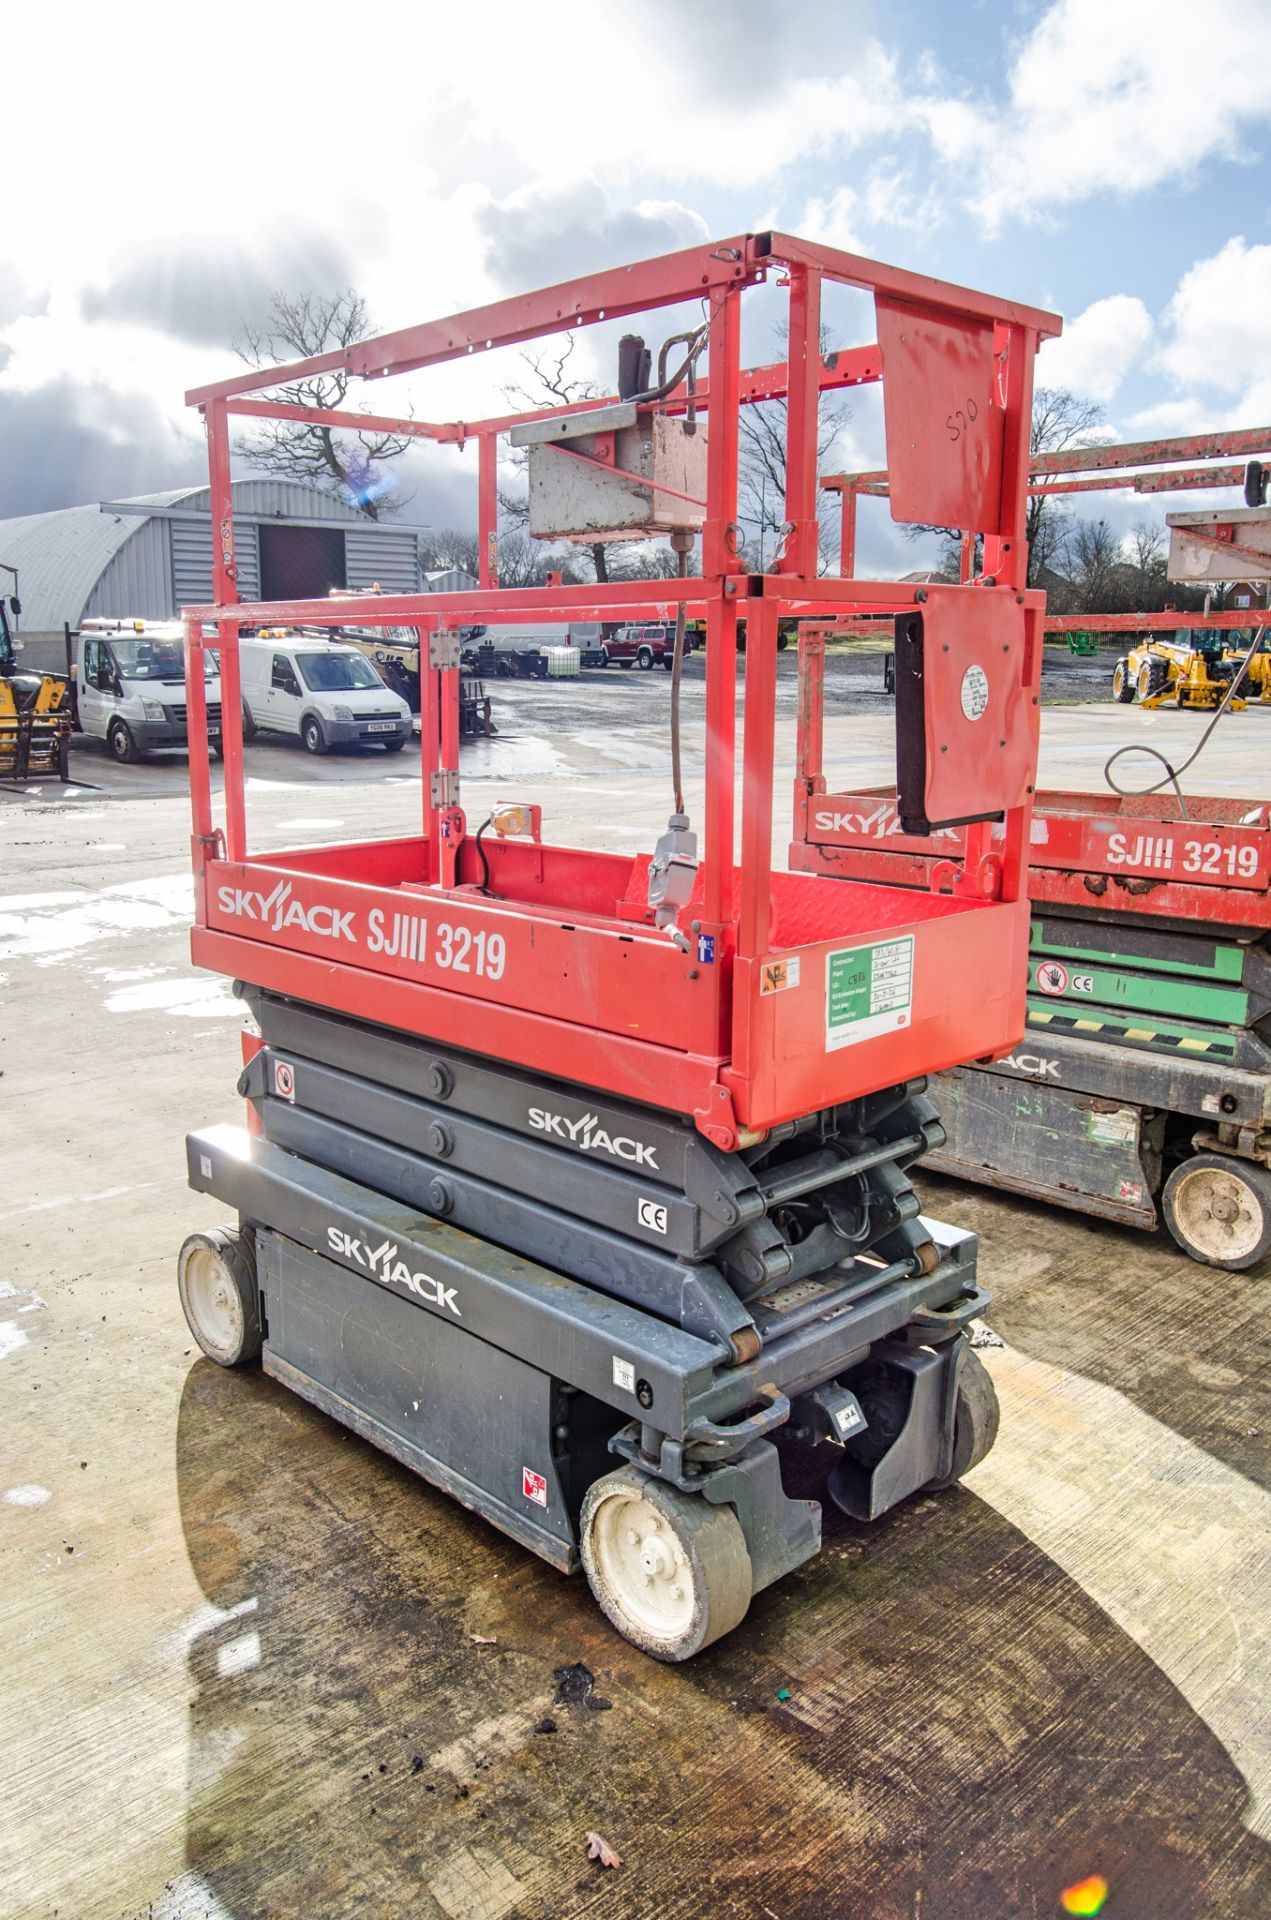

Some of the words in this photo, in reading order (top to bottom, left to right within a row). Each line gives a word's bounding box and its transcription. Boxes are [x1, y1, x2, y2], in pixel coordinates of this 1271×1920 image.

[1182, 840, 1259, 879] 3219
[217, 879, 358, 943] SKYJACK
[435, 923, 506, 981] 3219
[996, 1054, 1061, 1079] ACK
[528, 1107, 660, 1170] SKYJACK
[327, 1226, 462, 1317] SKYJACK
